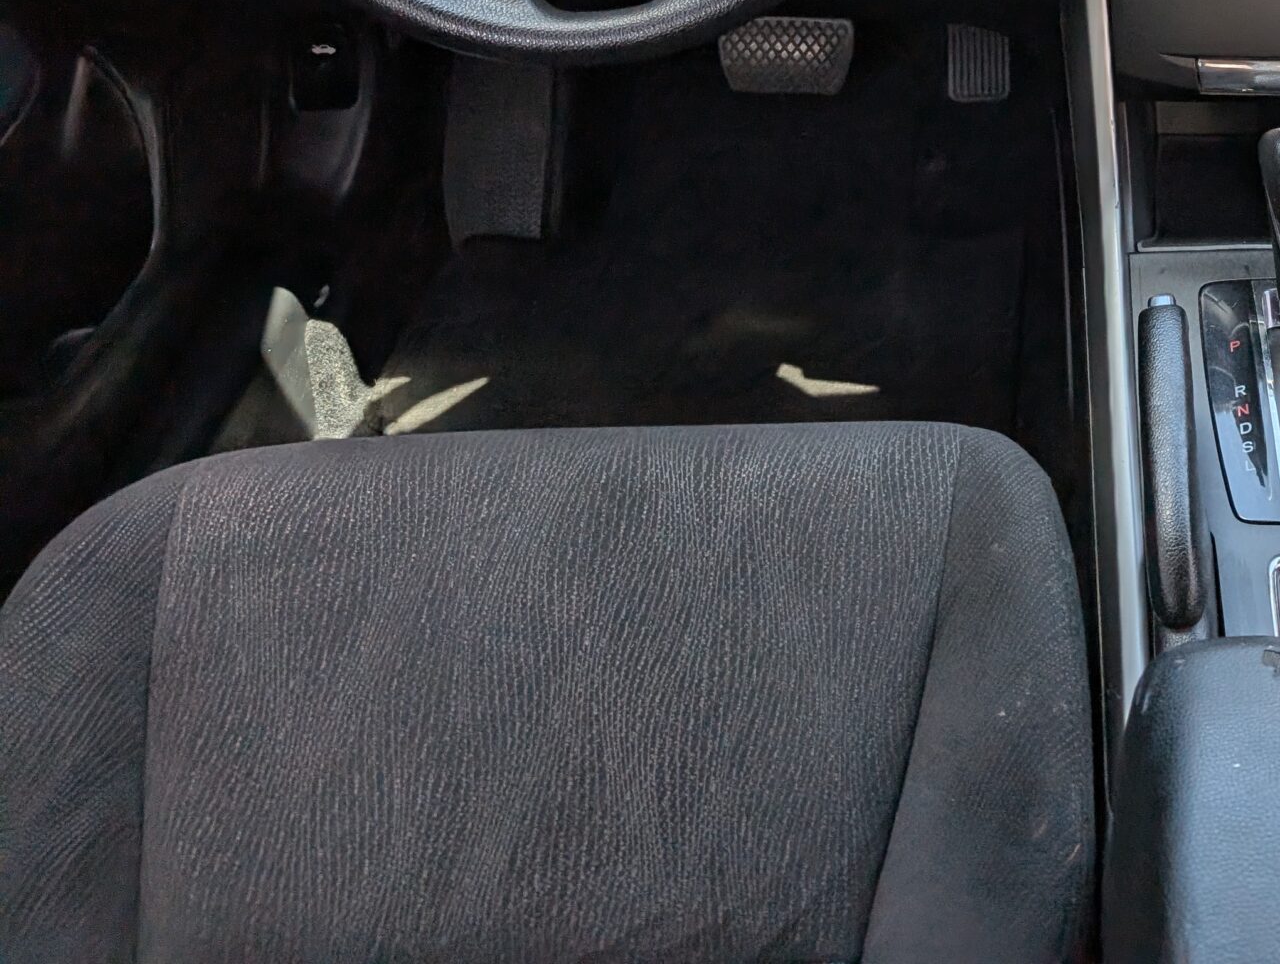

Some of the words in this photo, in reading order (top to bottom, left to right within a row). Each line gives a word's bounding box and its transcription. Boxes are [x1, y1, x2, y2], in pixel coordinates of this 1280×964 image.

[1229, 340, 1241, 353] P
[1234, 384, 1247, 398] R
[1237, 403, 1250, 417] N
[1240, 422, 1252, 435] D
[1242, 441, 1254, 453] S
[1245, 461, 1256, 472] L
